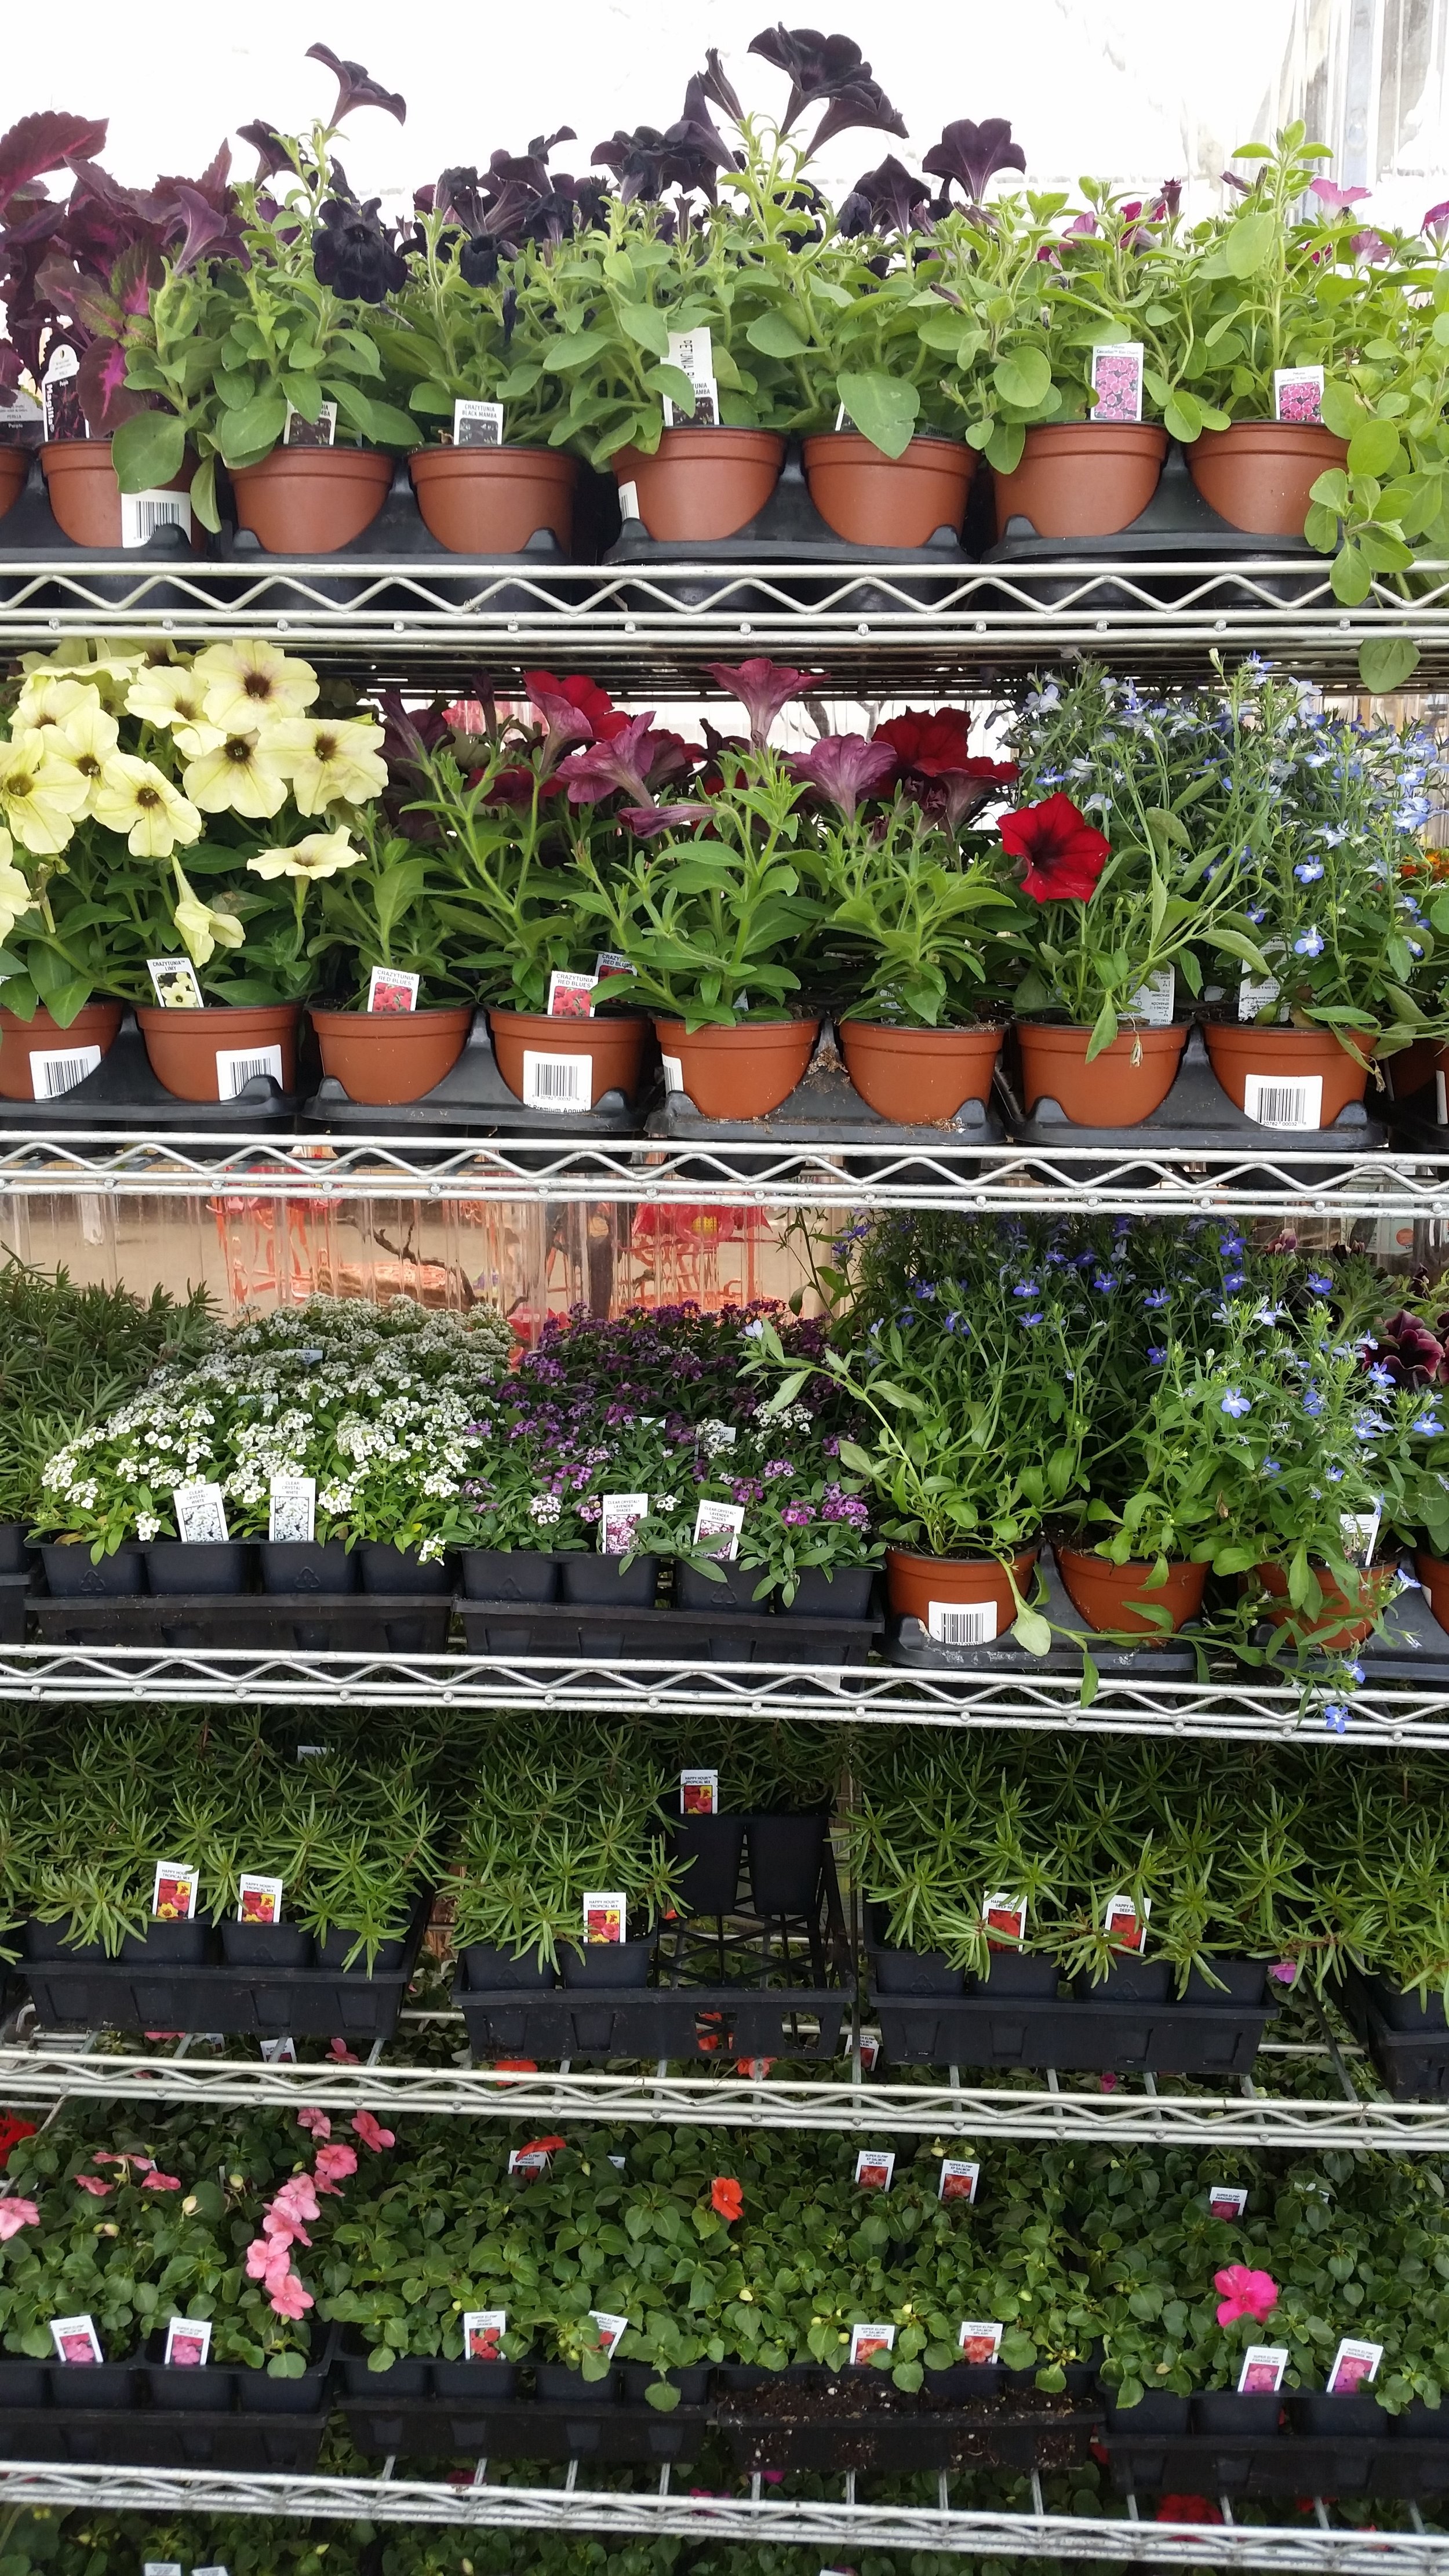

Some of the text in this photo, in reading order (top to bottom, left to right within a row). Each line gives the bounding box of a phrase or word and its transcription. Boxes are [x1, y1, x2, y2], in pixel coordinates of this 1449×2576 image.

[679, 340, 694, 369] PETUNIA
[465, 403, 495, 412] CRAZYTUNIA
[377, 970, 414, 981] CRAZYTUNIA
[556, 973, 594, 983] CRAZYTUNIA
[392, 978, 412, 986] BLUES
